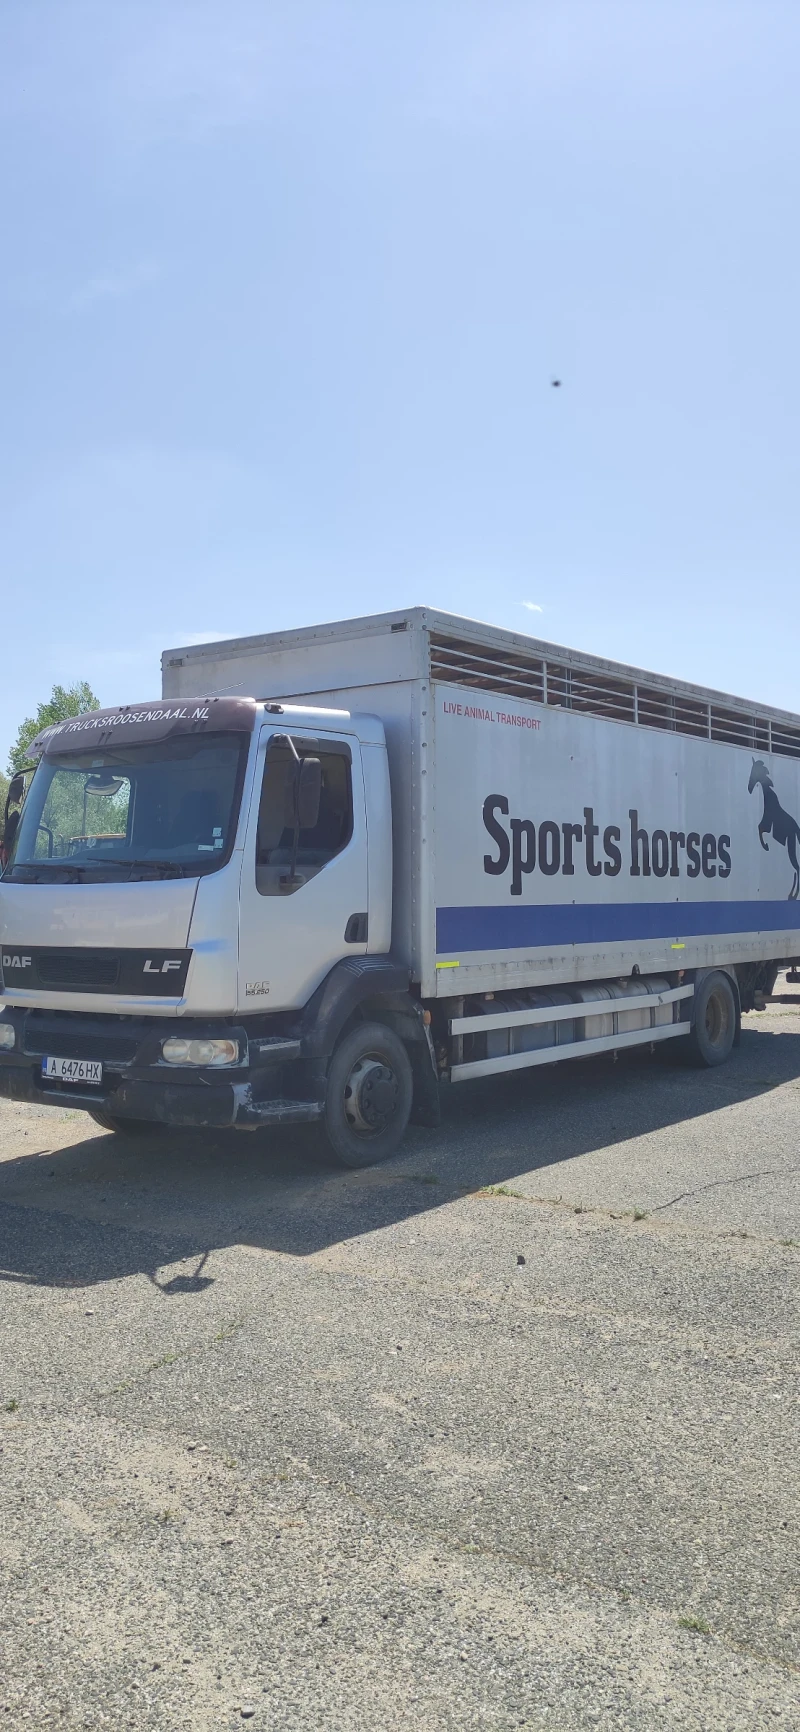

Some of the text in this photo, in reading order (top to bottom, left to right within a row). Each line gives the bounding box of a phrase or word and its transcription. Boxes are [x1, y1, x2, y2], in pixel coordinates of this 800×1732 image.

[42, 707, 210, 739] WWW.TRUCKSROOSENDAAL.NL
[443, 702, 541, 730] LIVE ANIMAL TRANSPORT
[483, 794, 732, 895] Sports horses
[3, 955, 182, 973] DAF LF
[245, 981, 270, 989] DAF
[51, 1060, 99, 1079] A 6476 HX
